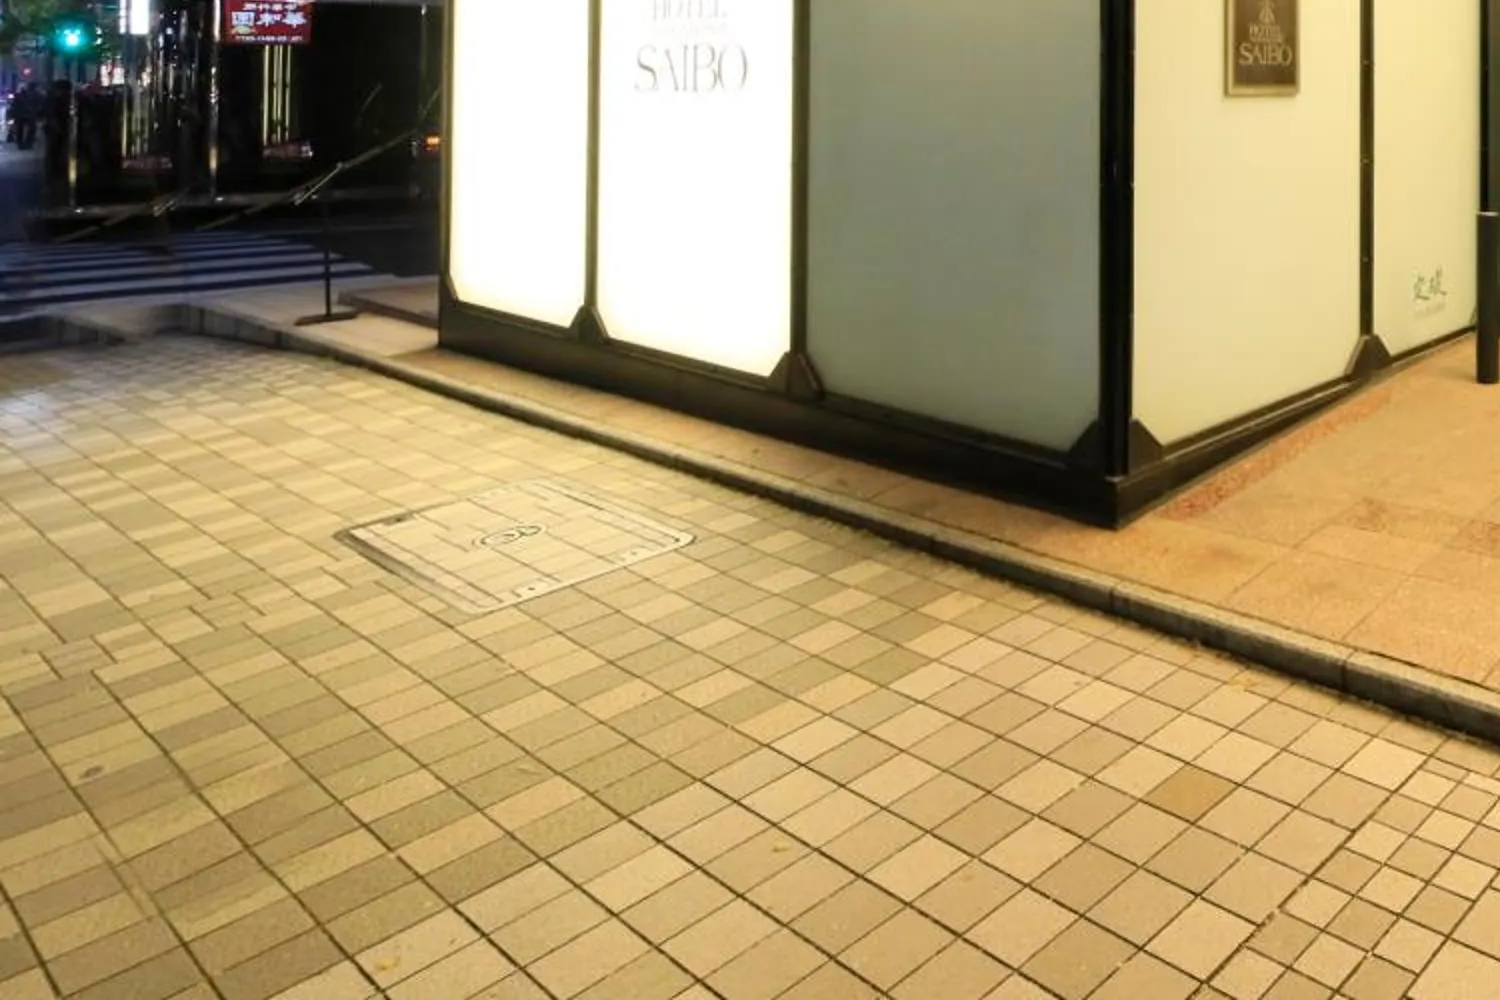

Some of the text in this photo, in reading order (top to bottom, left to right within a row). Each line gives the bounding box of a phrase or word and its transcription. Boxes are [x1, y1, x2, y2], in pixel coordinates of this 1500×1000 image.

[1248, 21, 1282, 39] HOTEL
[1239, 42, 1293, 66] SAIBO
[634, 42, 749, 93] SAIBO
